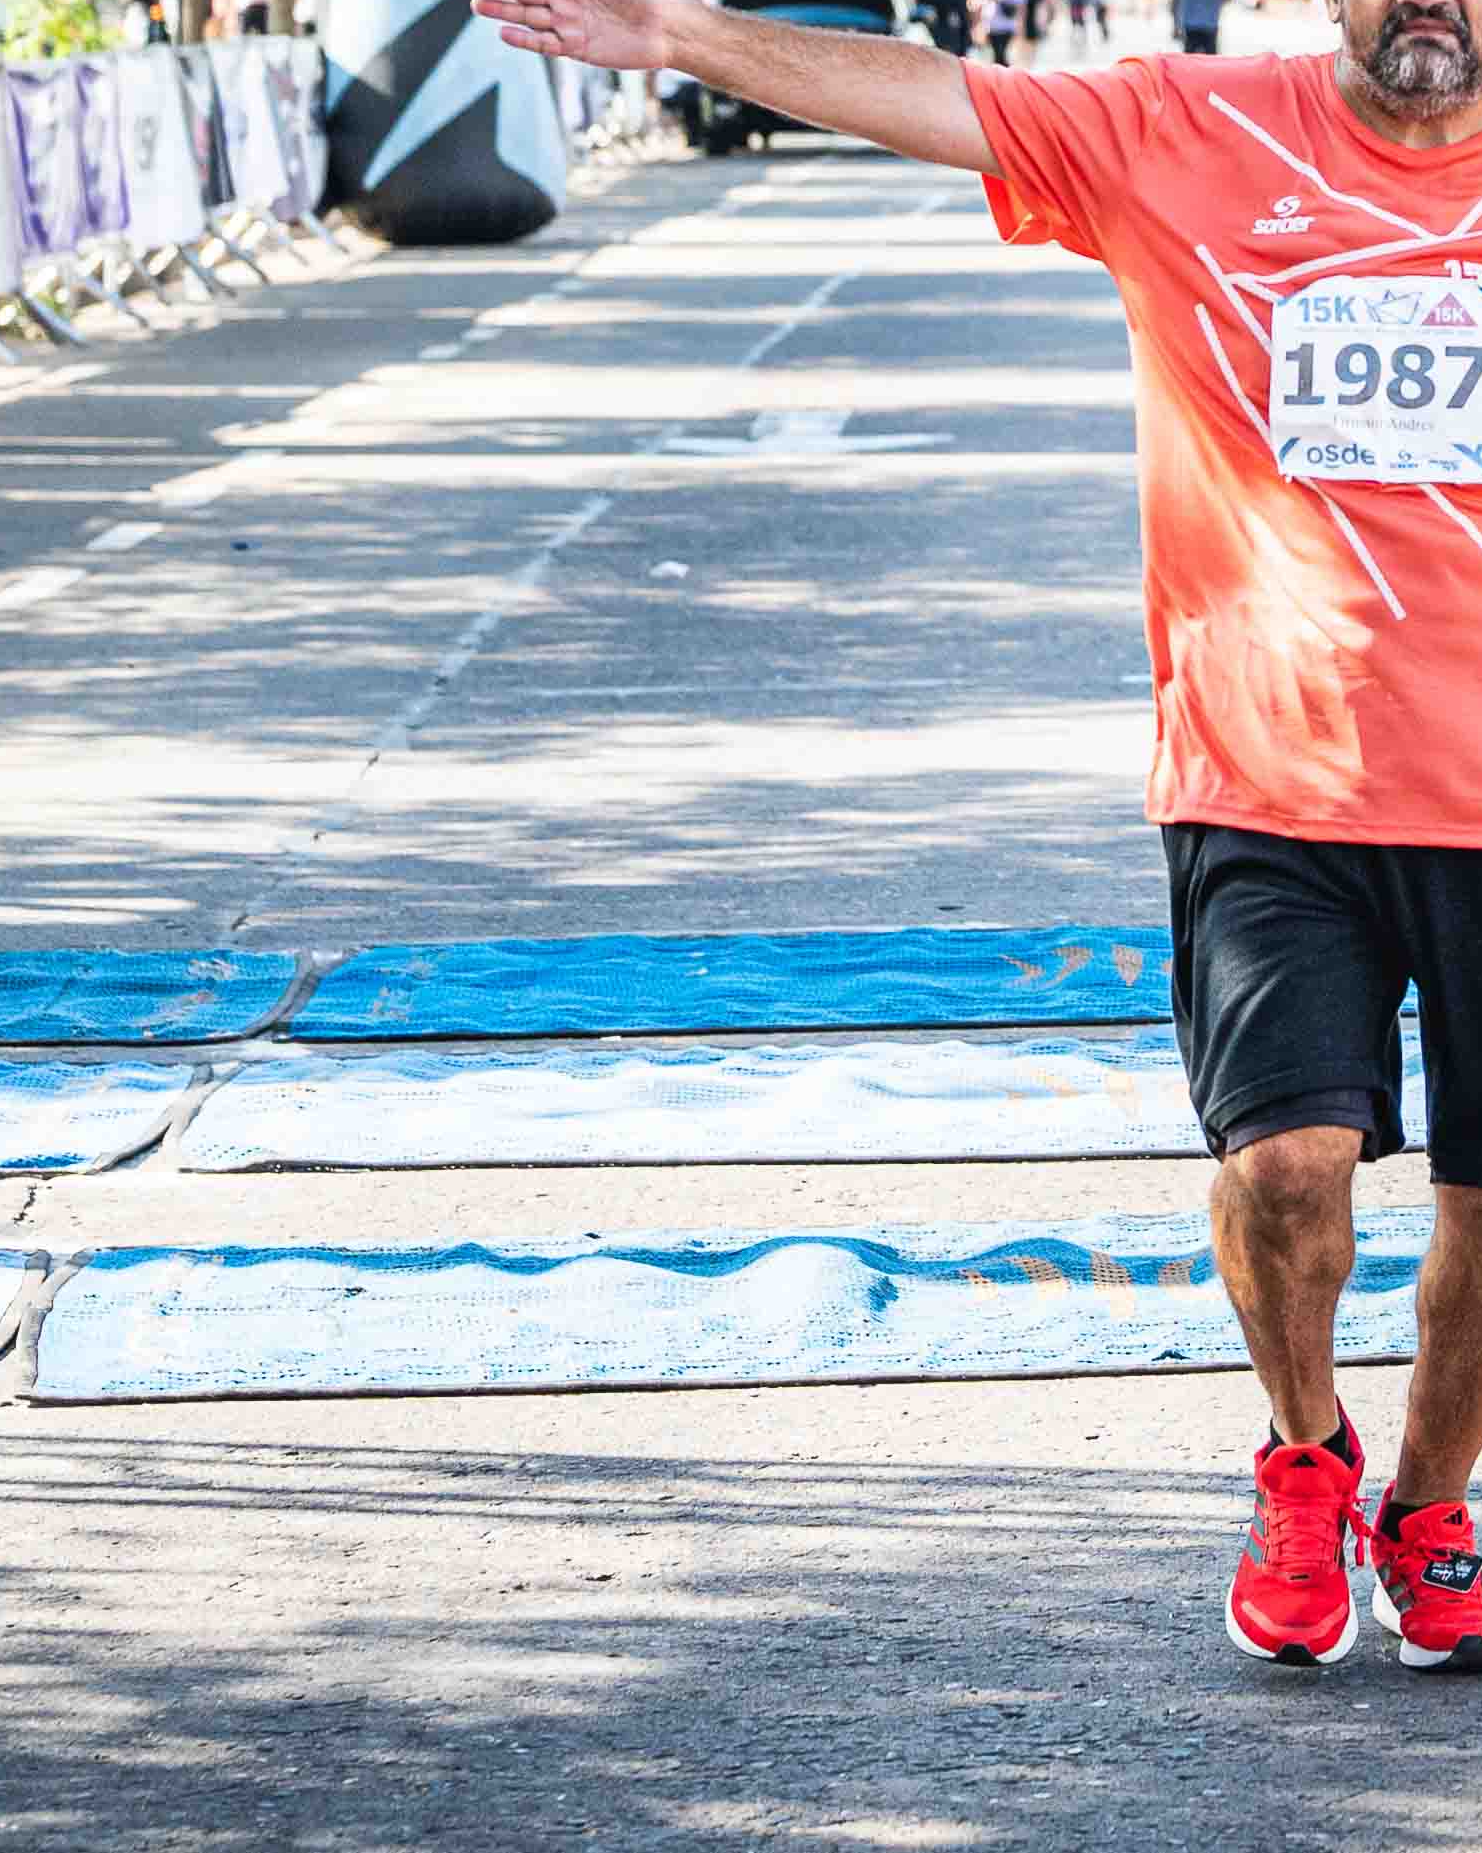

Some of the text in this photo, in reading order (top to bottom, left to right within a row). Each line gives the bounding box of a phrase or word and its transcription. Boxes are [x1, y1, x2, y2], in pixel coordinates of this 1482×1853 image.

[1297, 295, 1467, 324] 15K 15K
[1306, 443, 1376, 468] osde
